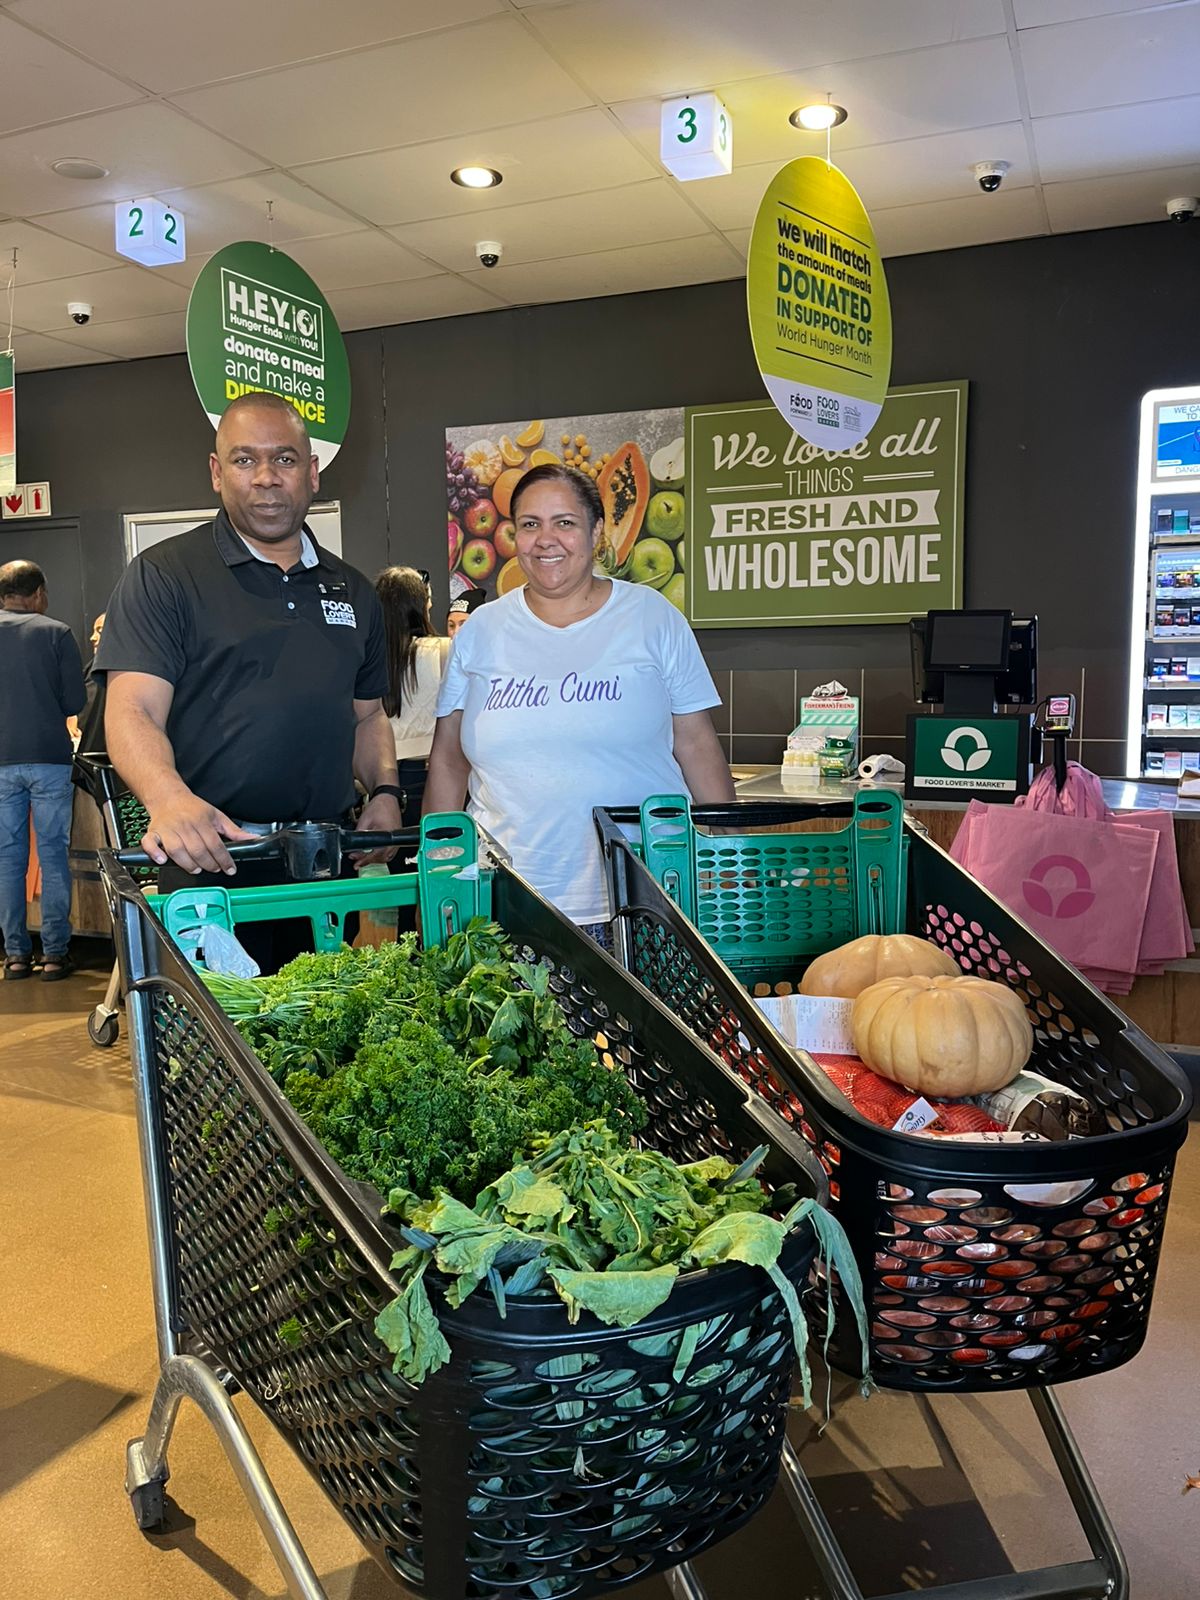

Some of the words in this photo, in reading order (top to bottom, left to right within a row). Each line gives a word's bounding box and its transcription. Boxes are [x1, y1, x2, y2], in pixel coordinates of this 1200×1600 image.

[677, 107, 697, 143] 3
[719, 114, 727, 151] 3
[129, 207, 144, 237] 2
[164, 213, 177, 245] 2
[777, 242, 795, 261] the
[797, 253, 835, 277] amount
[836, 268, 846, 282] of
[847, 274, 871, 294] meals
[778, 218, 801, 243] we
[803, 229, 827, 255] will
[830, 241, 871, 277] match
[228, 280, 290, 330] H.E.Y.
[778, 262, 871, 323] DONATED
[229, 312, 262, 332] Hunger
[262, 324, 283, 339] Ends
[283, 332, 300, 346] with
[299, 337, 318, 352] YOU!
[777, 296, 791, 319] IN
[794, 303, 855, 340] SUPPORT
[857, 326, 872, 346] OF
[223, 335, 280, 366] donate
[280, 355, 291, 370] a
[292, 359, 325, 381] meal
[777, 321, 807, 344] World
[810, 333, 844, 355] Hunger
[846, 344, 872, 365] Month
[225, 359, 260, 384] and
[266, 370, 312, 398] make
[315, 386, 325, 402] a
[816, 395, 840, 411] FOOD
[712, 432, 777, 471] We
[879, 417, 941, 458] all
[785, 466, 854, 496] THINGS
[726, 503, 831, 534] FRESH
[841, 497, 919, 527] AND
[704, 533, 941, 592] WHOLESOME
[320, 599, 354, 613] FOOD
[483, 674, 550, 711] Talitha
[560, 671, 622, 703] Cumi
